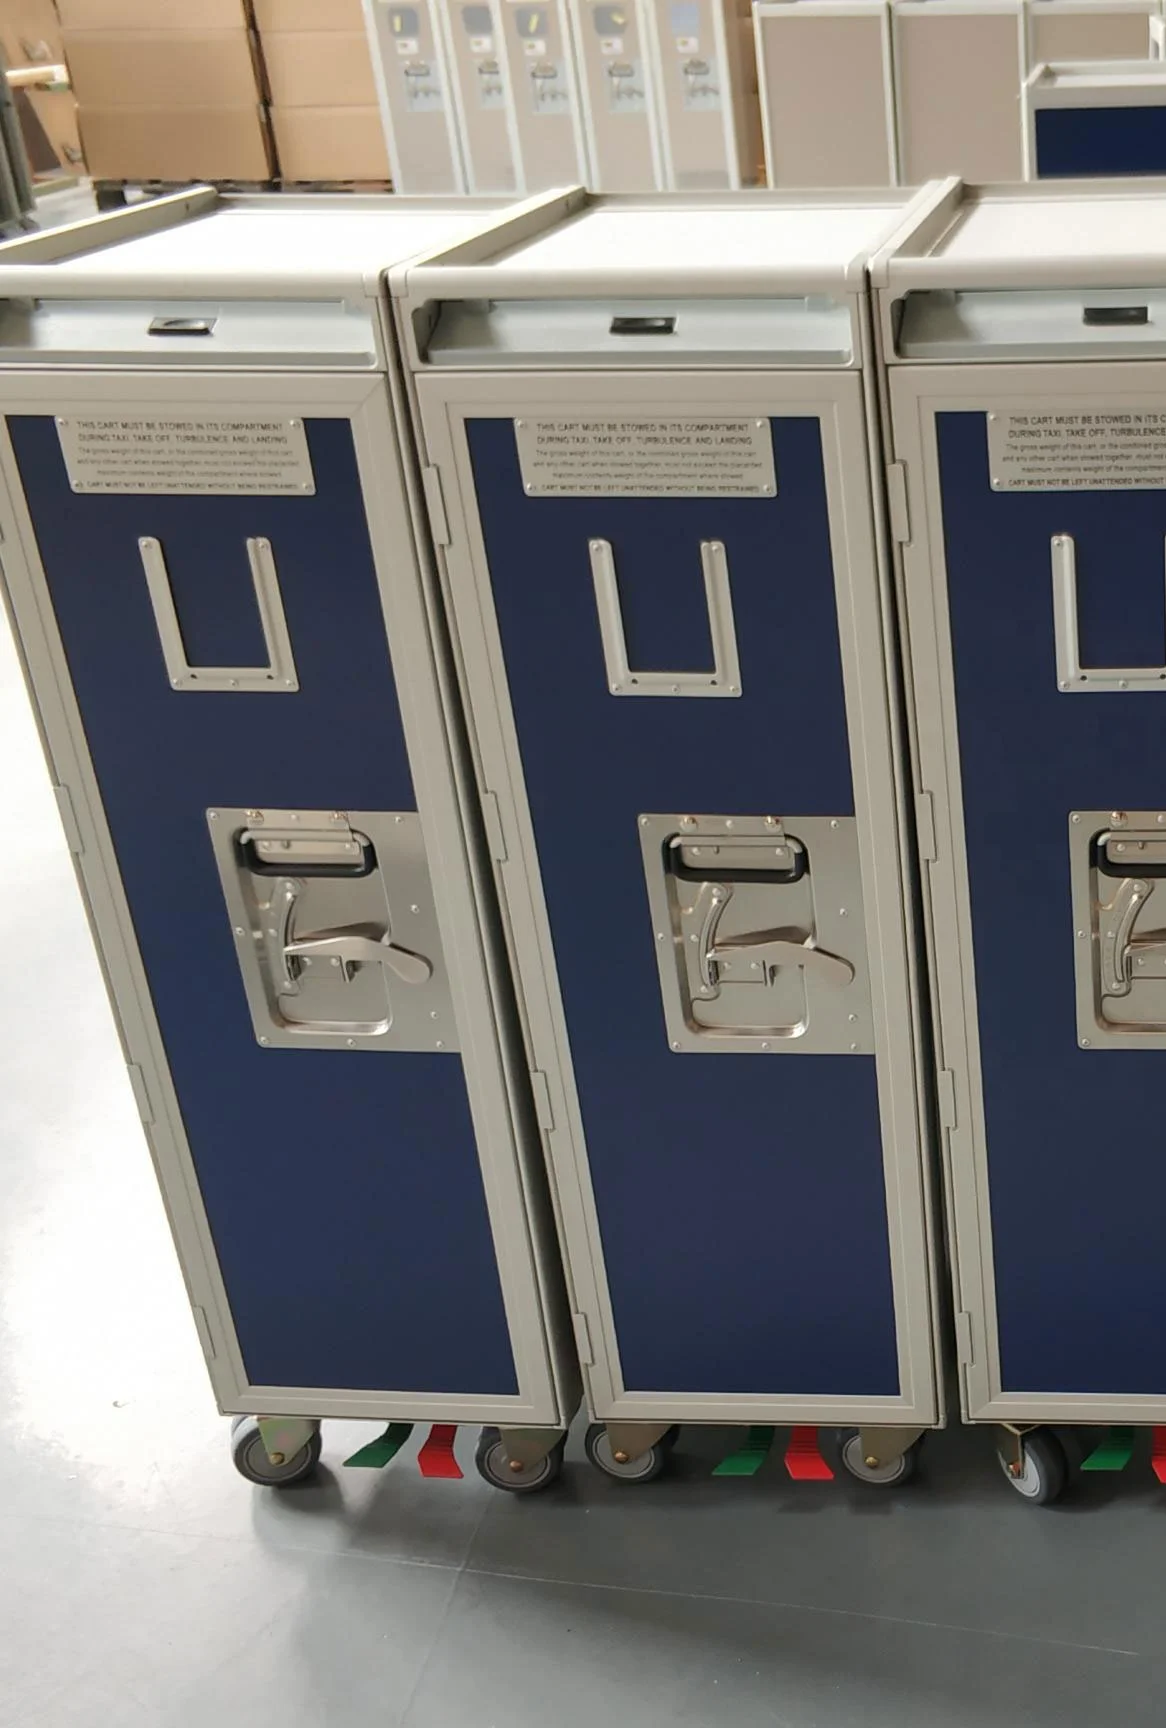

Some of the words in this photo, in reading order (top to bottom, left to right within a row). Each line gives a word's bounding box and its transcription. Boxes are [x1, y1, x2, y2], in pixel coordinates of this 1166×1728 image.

[1009, 417, 1029, 425] THIS
[1030, 416, 1054, 425] CART
[1055, 416, 1079, 424] MUST
[1081, 415, 1093, 424] BE
[1094, 415, 1132, 424] STOWED
[1134, 415, 1143, 423] IN
[1144, 414, 1158, 423] ITS
[1008, 429, 1042, 438] DURING
[1065, 429, 1087, 437] TAKE
[1110, 427, 1166, 436] TURBULENCE
